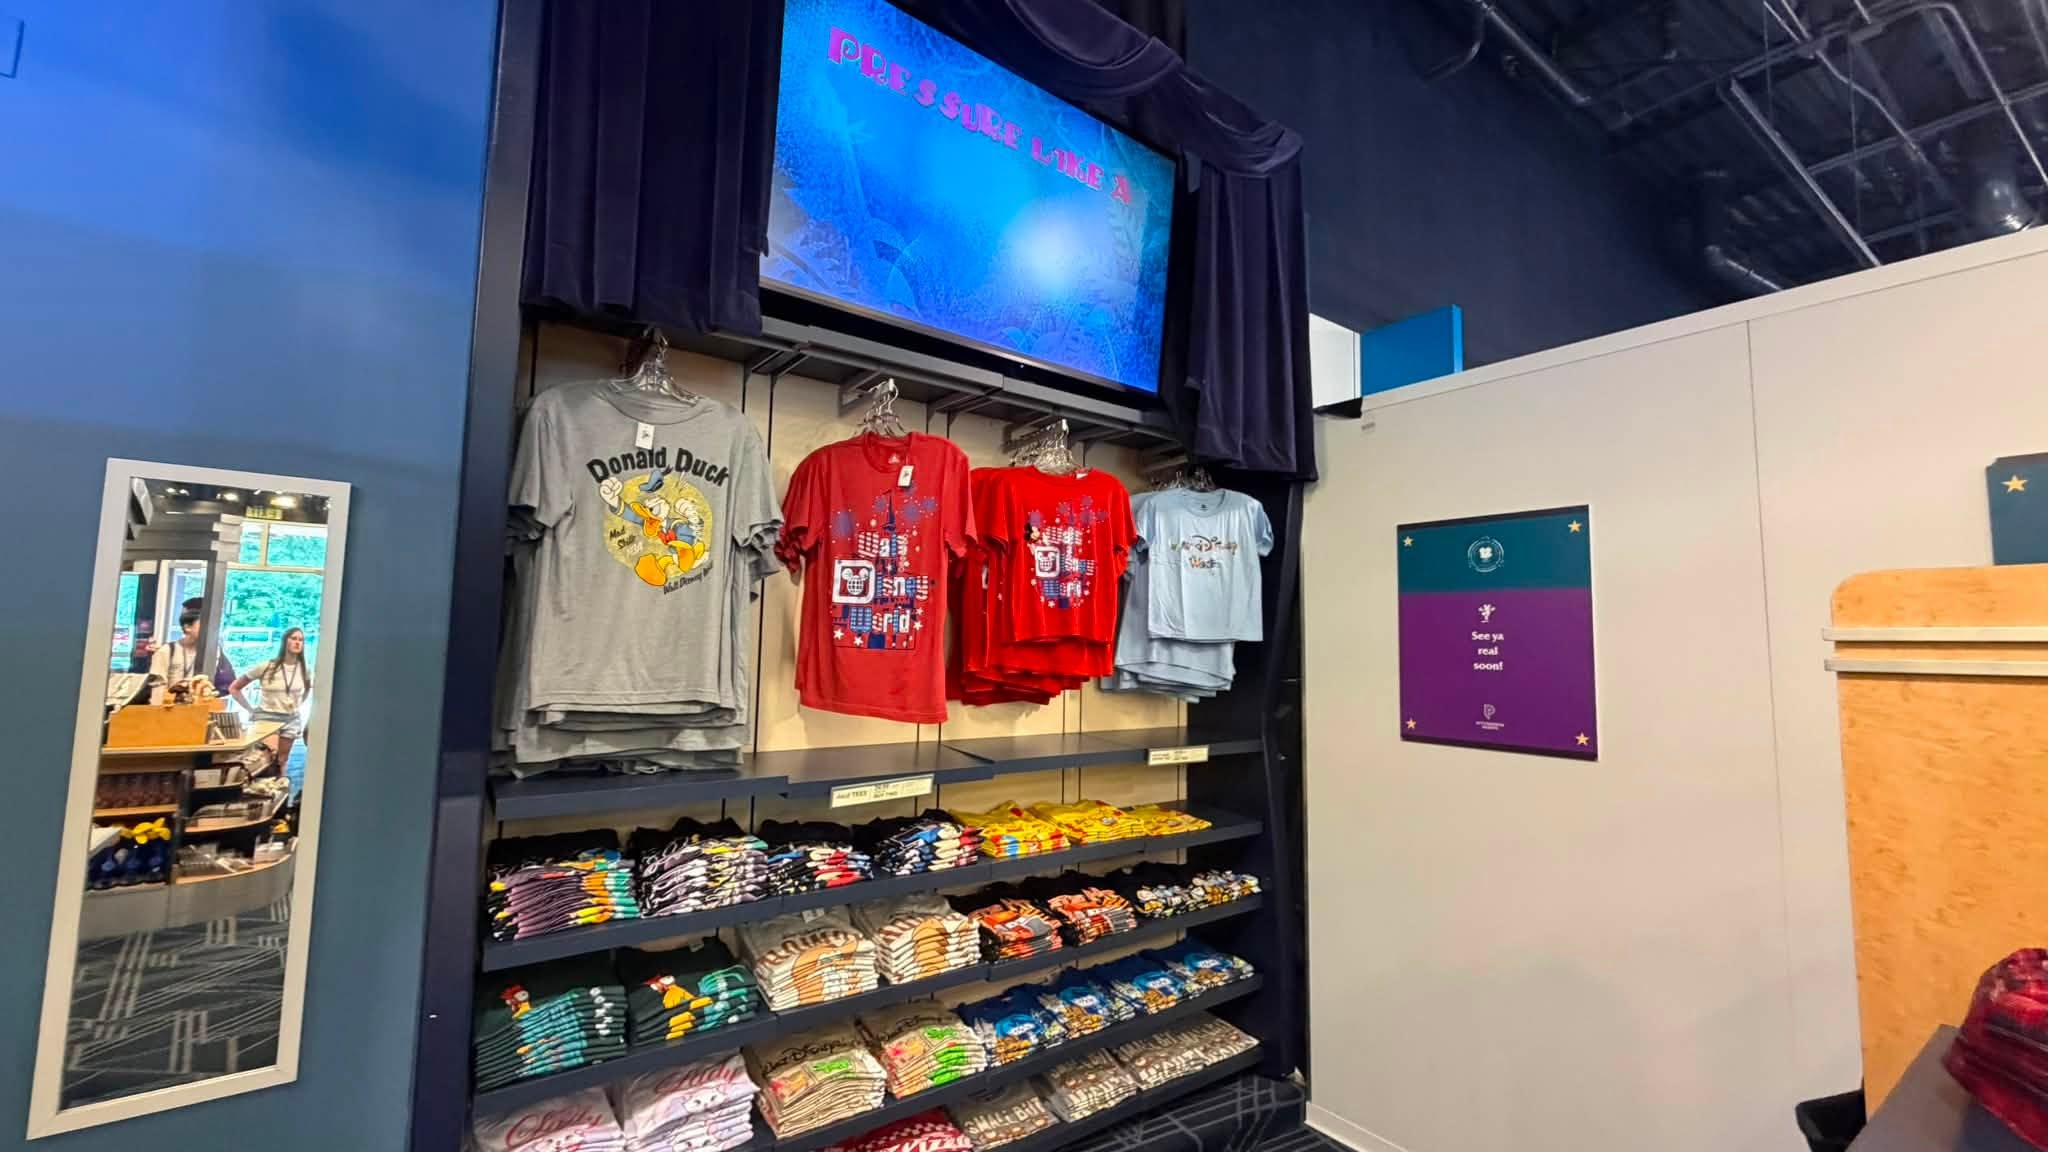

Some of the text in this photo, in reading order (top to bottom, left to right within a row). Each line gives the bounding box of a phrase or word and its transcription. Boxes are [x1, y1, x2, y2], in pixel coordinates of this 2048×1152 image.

[827, 26, 1133, 205] PRESSURE LIKE A
[586, 447, 730, 487] Donald Duck
[1471, 631, 1505, 643] See ya
[1477, 646, 1499, 656] real
[1473, 661, 1504, 671] soon!
